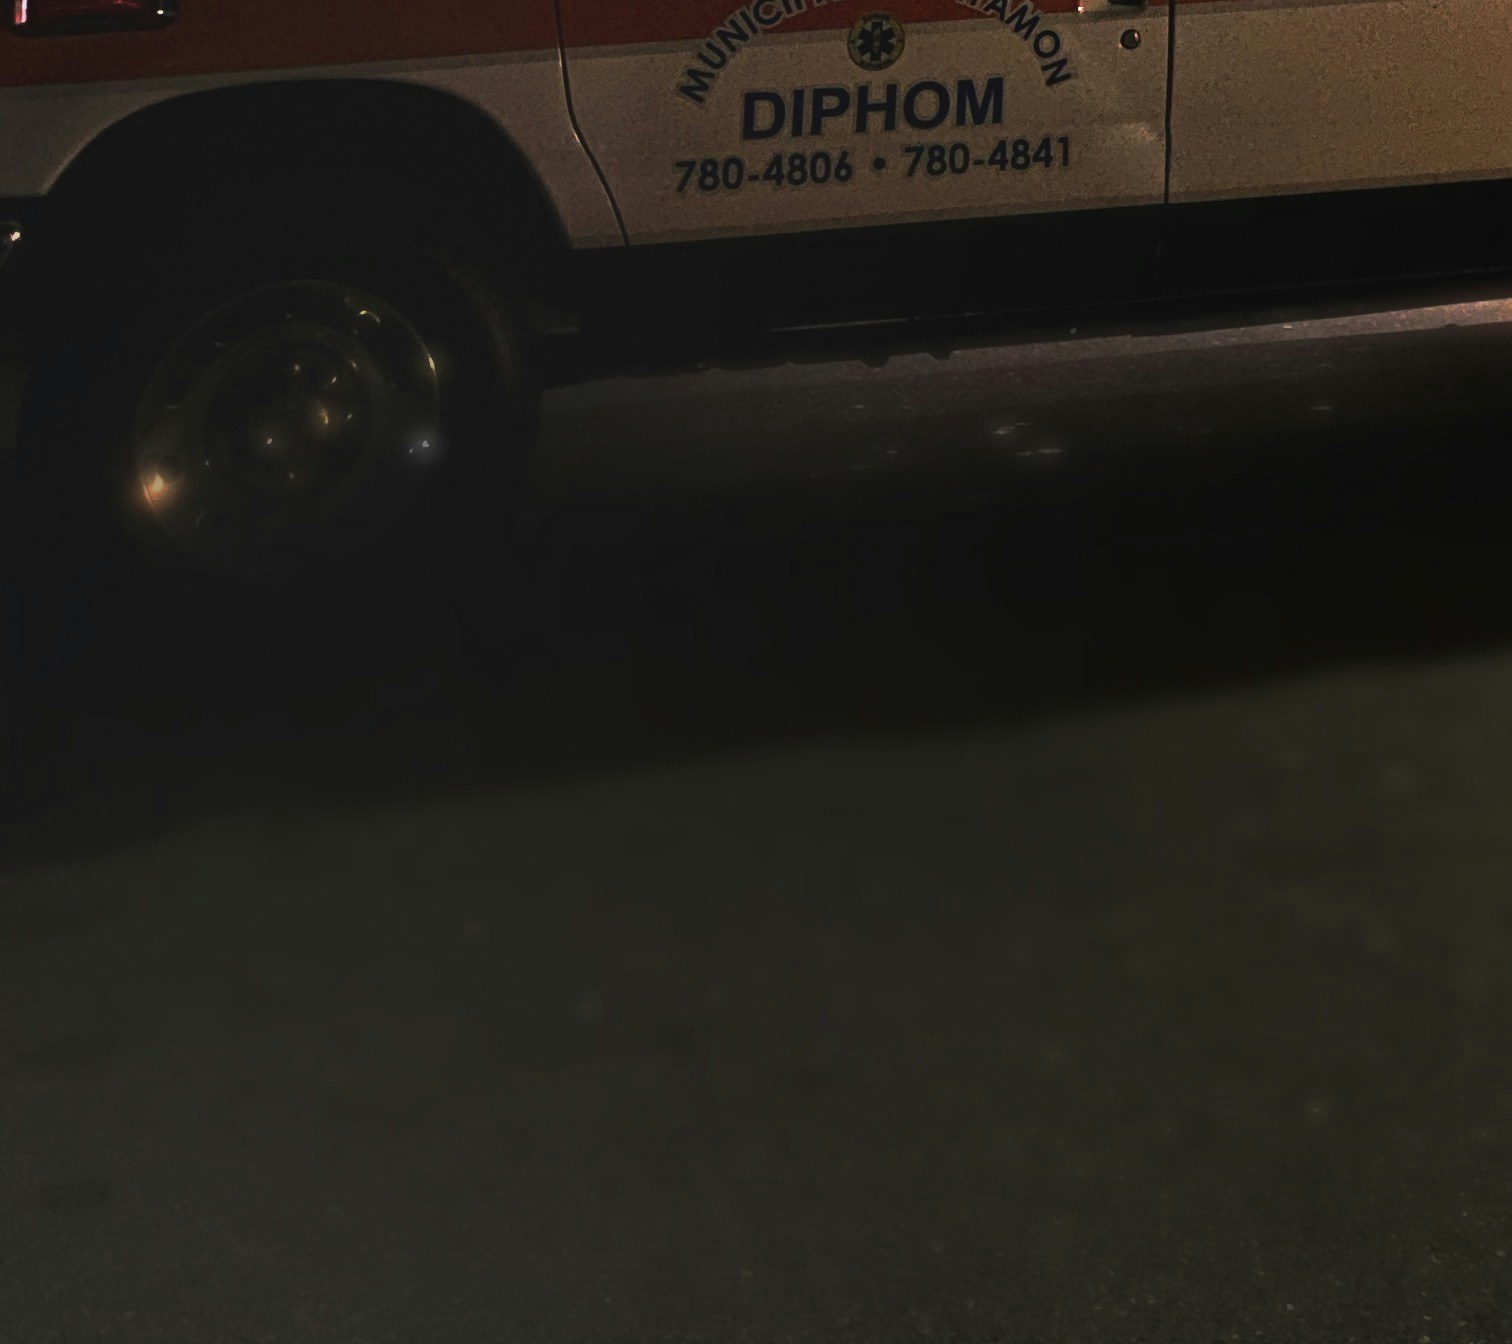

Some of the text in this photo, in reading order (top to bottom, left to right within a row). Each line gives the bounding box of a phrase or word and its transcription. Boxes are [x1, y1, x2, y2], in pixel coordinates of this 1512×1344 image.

[742, 77, 1005, 140] DIPHOM
[675, 136, 1070, 193] 780-4806 780-4841
